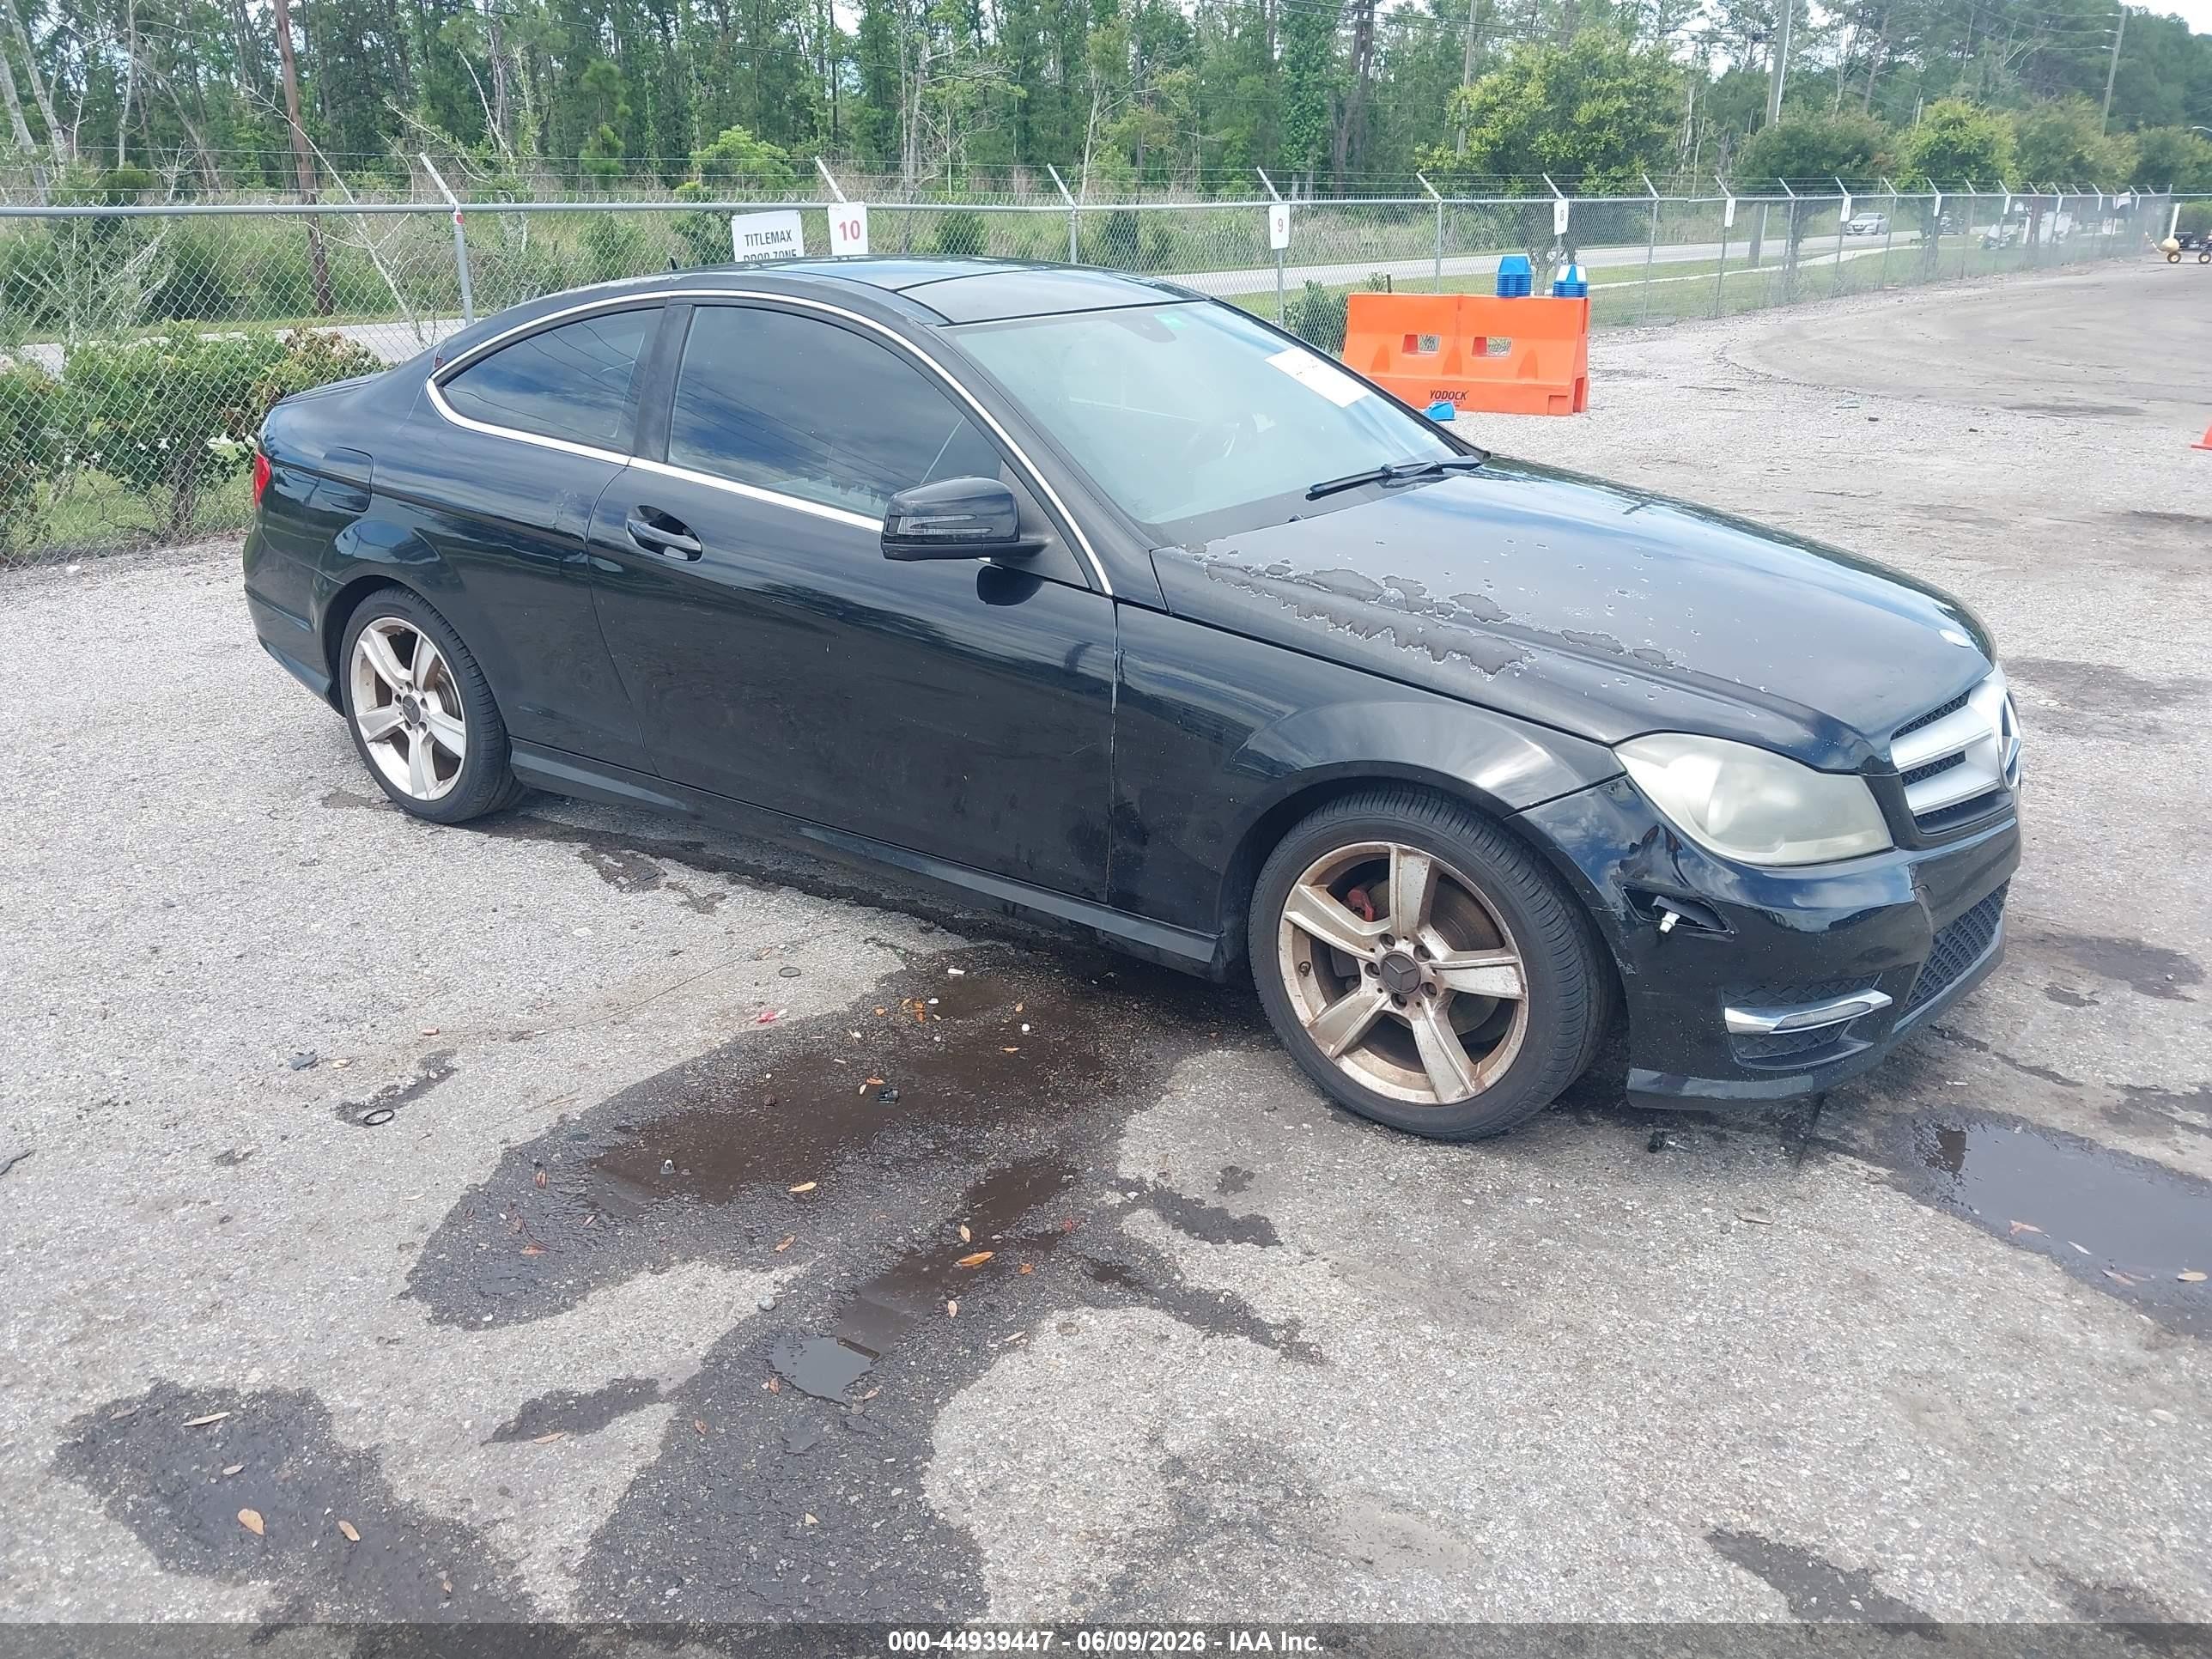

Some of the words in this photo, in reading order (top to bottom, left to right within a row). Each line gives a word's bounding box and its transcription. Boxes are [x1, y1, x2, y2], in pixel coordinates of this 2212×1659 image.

[838, 220, 860, 241] 10
[1278, 217, 1284, 233] 9
[744, 228, 793, 246] TITLEMAX
[1430, 389, 1469, 400] YODOCK
